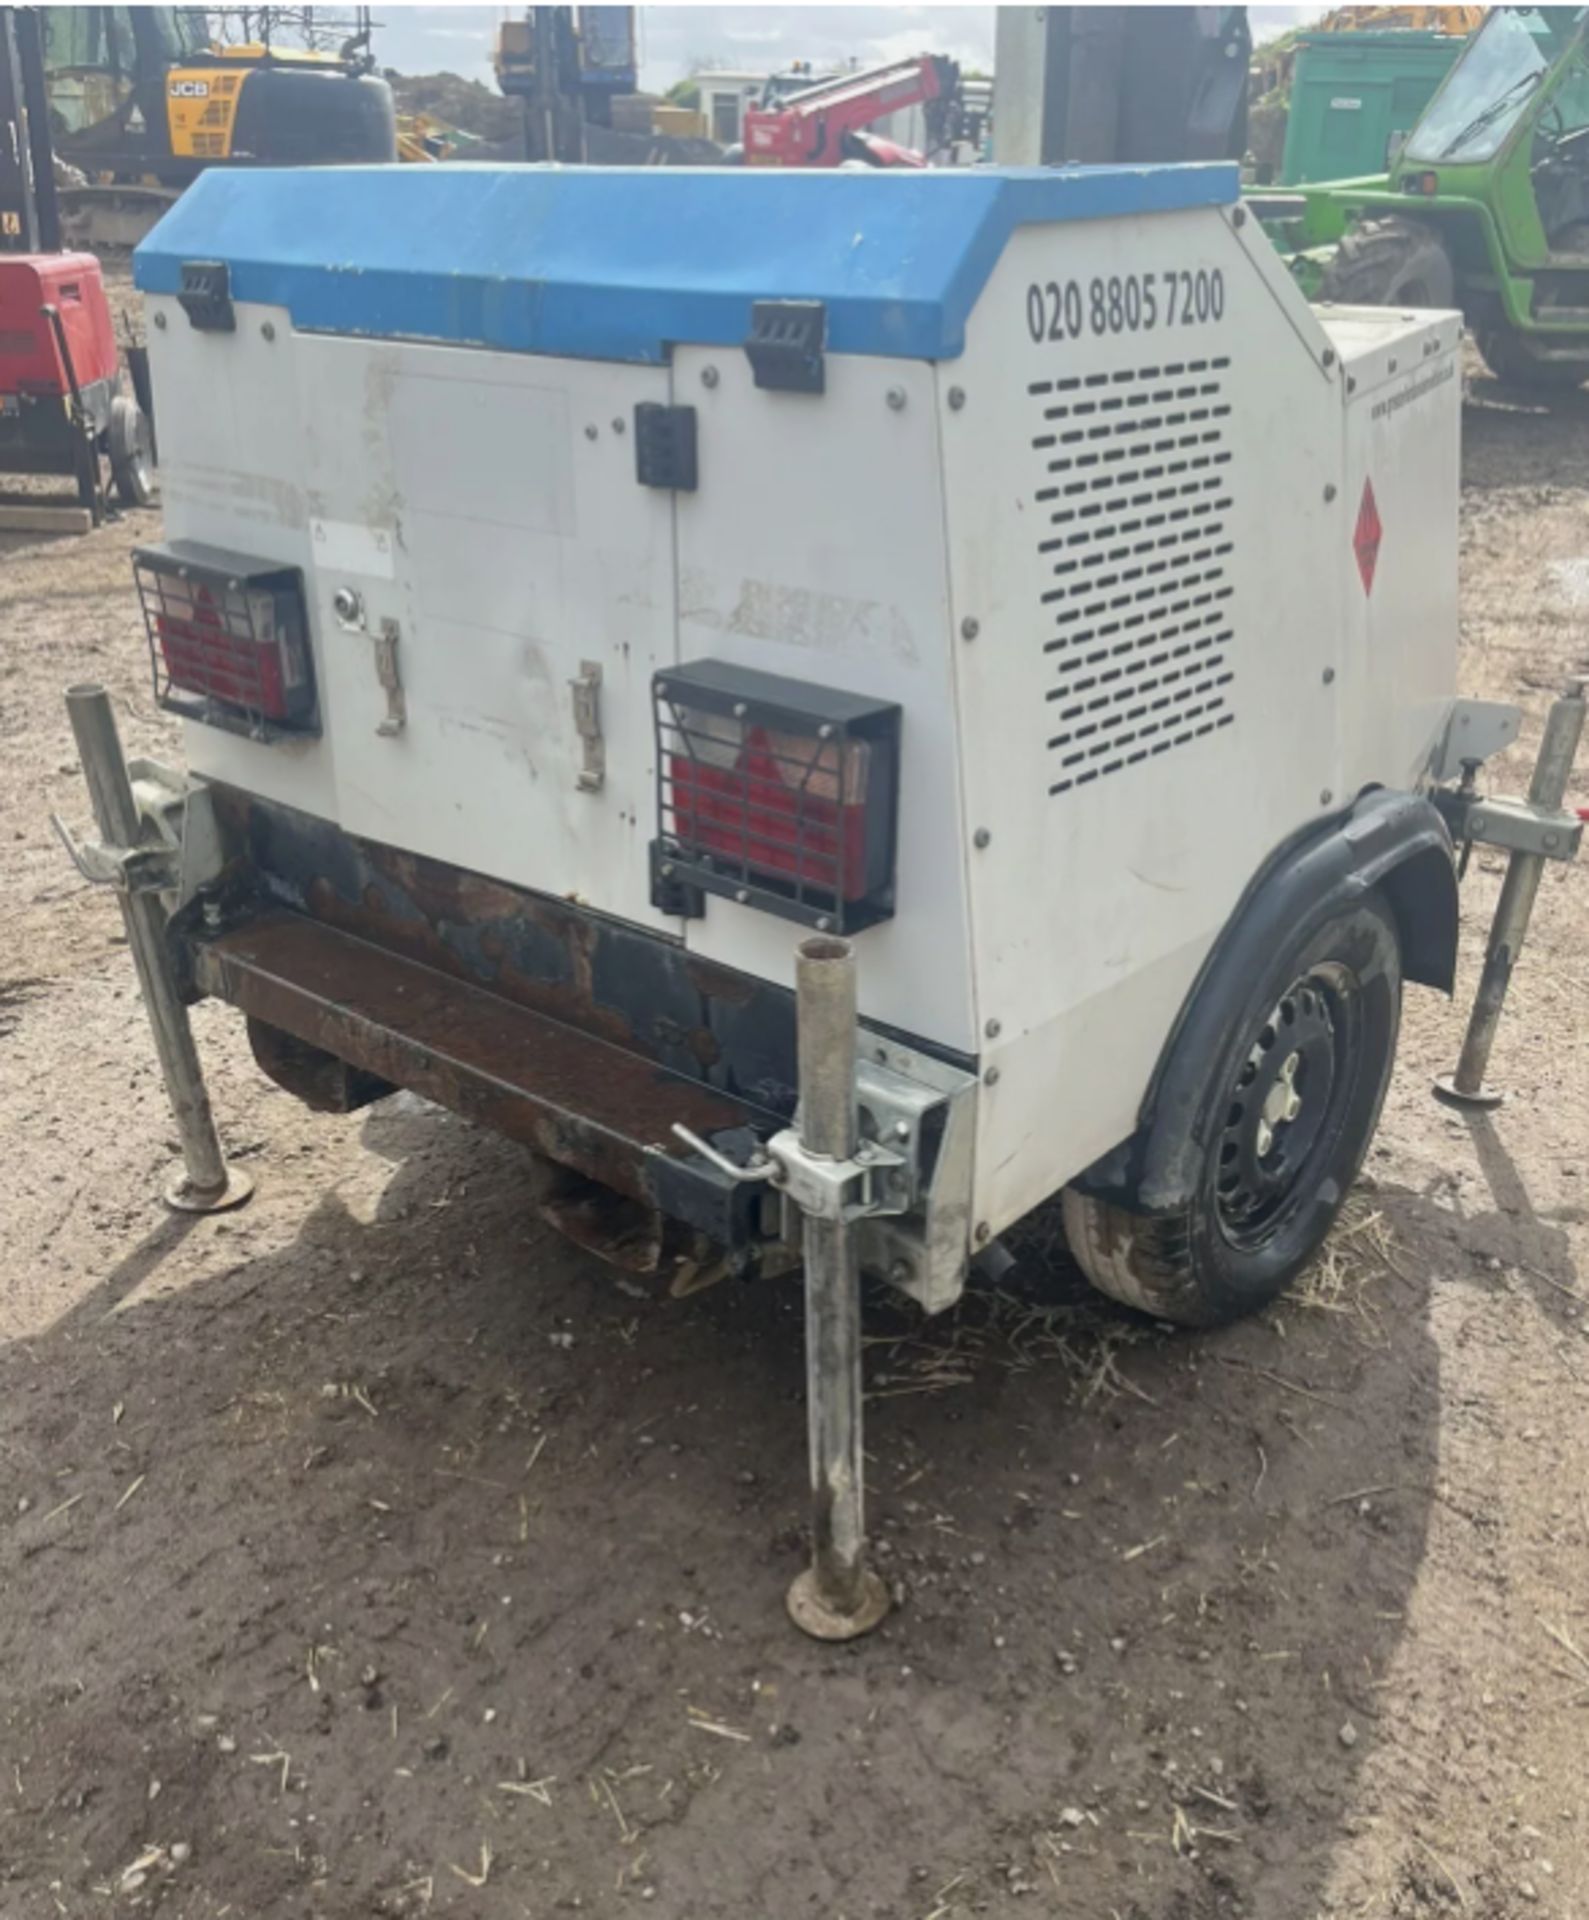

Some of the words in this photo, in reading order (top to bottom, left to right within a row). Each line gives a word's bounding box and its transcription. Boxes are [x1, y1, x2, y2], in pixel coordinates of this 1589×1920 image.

[170, 81, 207, 96] JCB
[1027, 279, 1082, 343] 020
[1089, 273, 1158, 336] 8805
[1163, 267, 1224, 327] 7200
